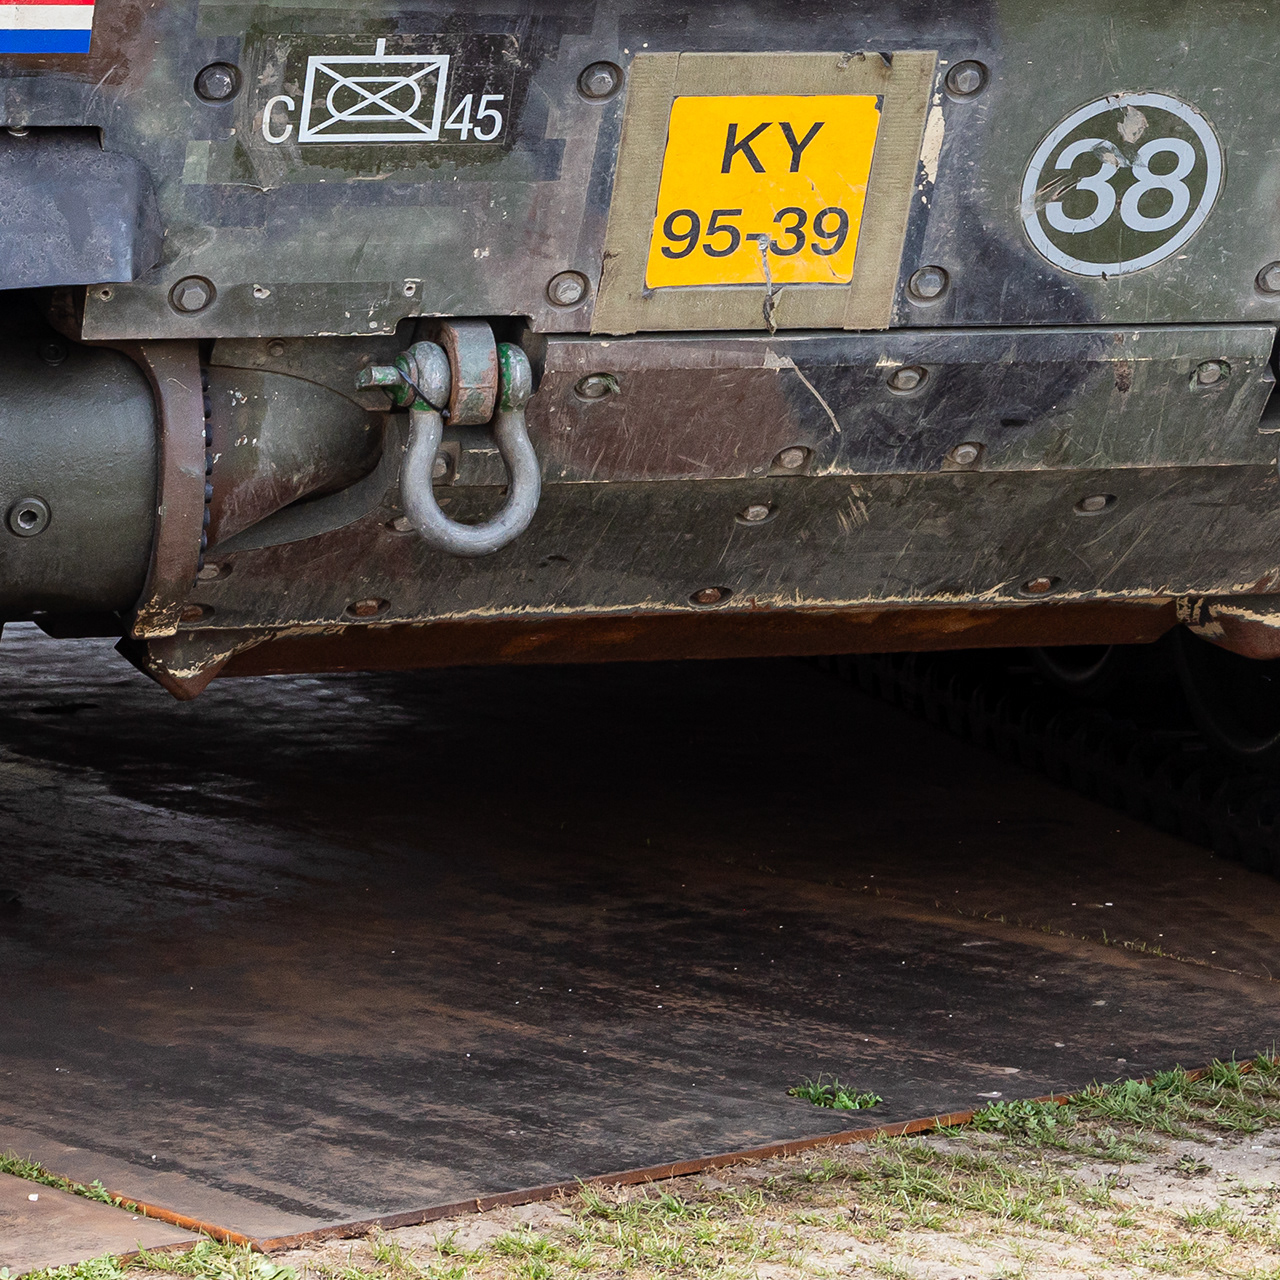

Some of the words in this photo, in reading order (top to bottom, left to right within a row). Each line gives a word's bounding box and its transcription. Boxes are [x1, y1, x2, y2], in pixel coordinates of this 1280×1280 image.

[262, 95, 295, 143] C
[444, 94, 504, 140] 45
[721, 122, 825, 173] KY
[1045, 137, 1196, 233] 38
[661, 207, 849, 259] 95-39
